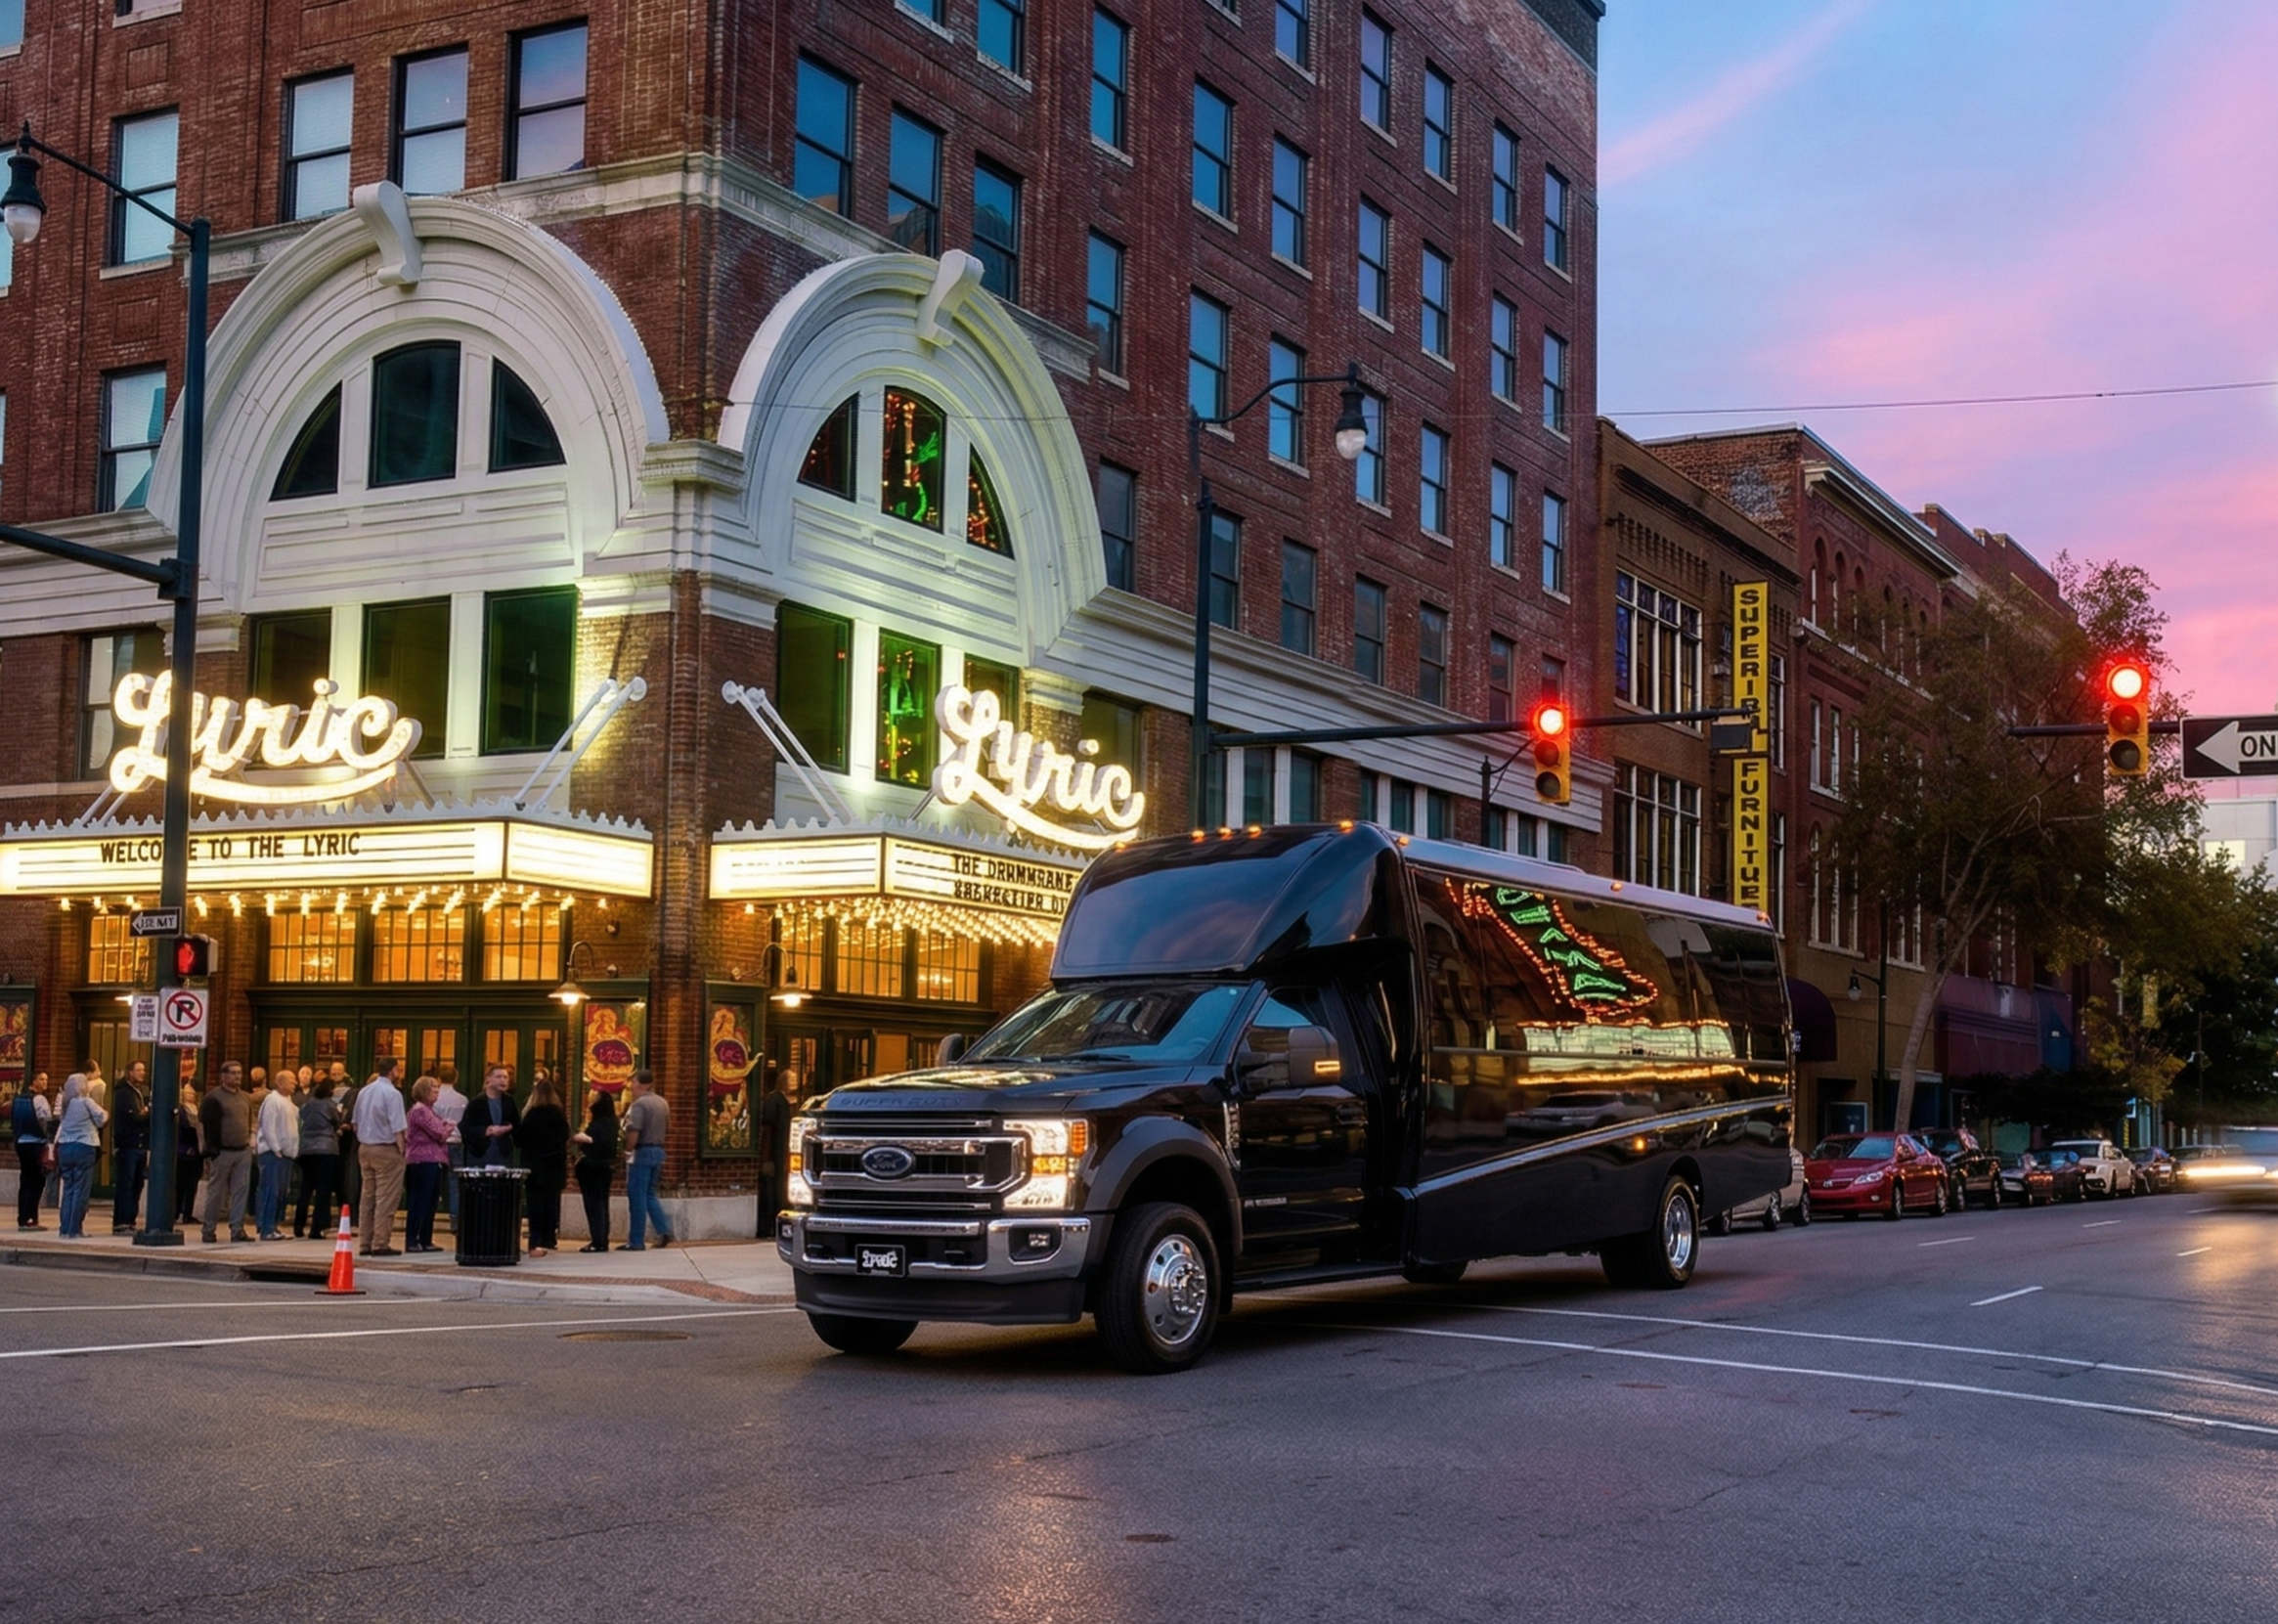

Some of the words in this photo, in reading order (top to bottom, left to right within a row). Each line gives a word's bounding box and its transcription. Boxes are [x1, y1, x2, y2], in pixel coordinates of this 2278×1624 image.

[110, 669, 421, 804] Lyric
[933, 685, 1146, 850] Lyric
[101, 840, 198, 862] WELCOE
[207, 837, 232, 859] TO
[246, 835, 285, 858] THE
[303, 832, 361, 856] LYRIC
[952, 854, 981, 877] THE
